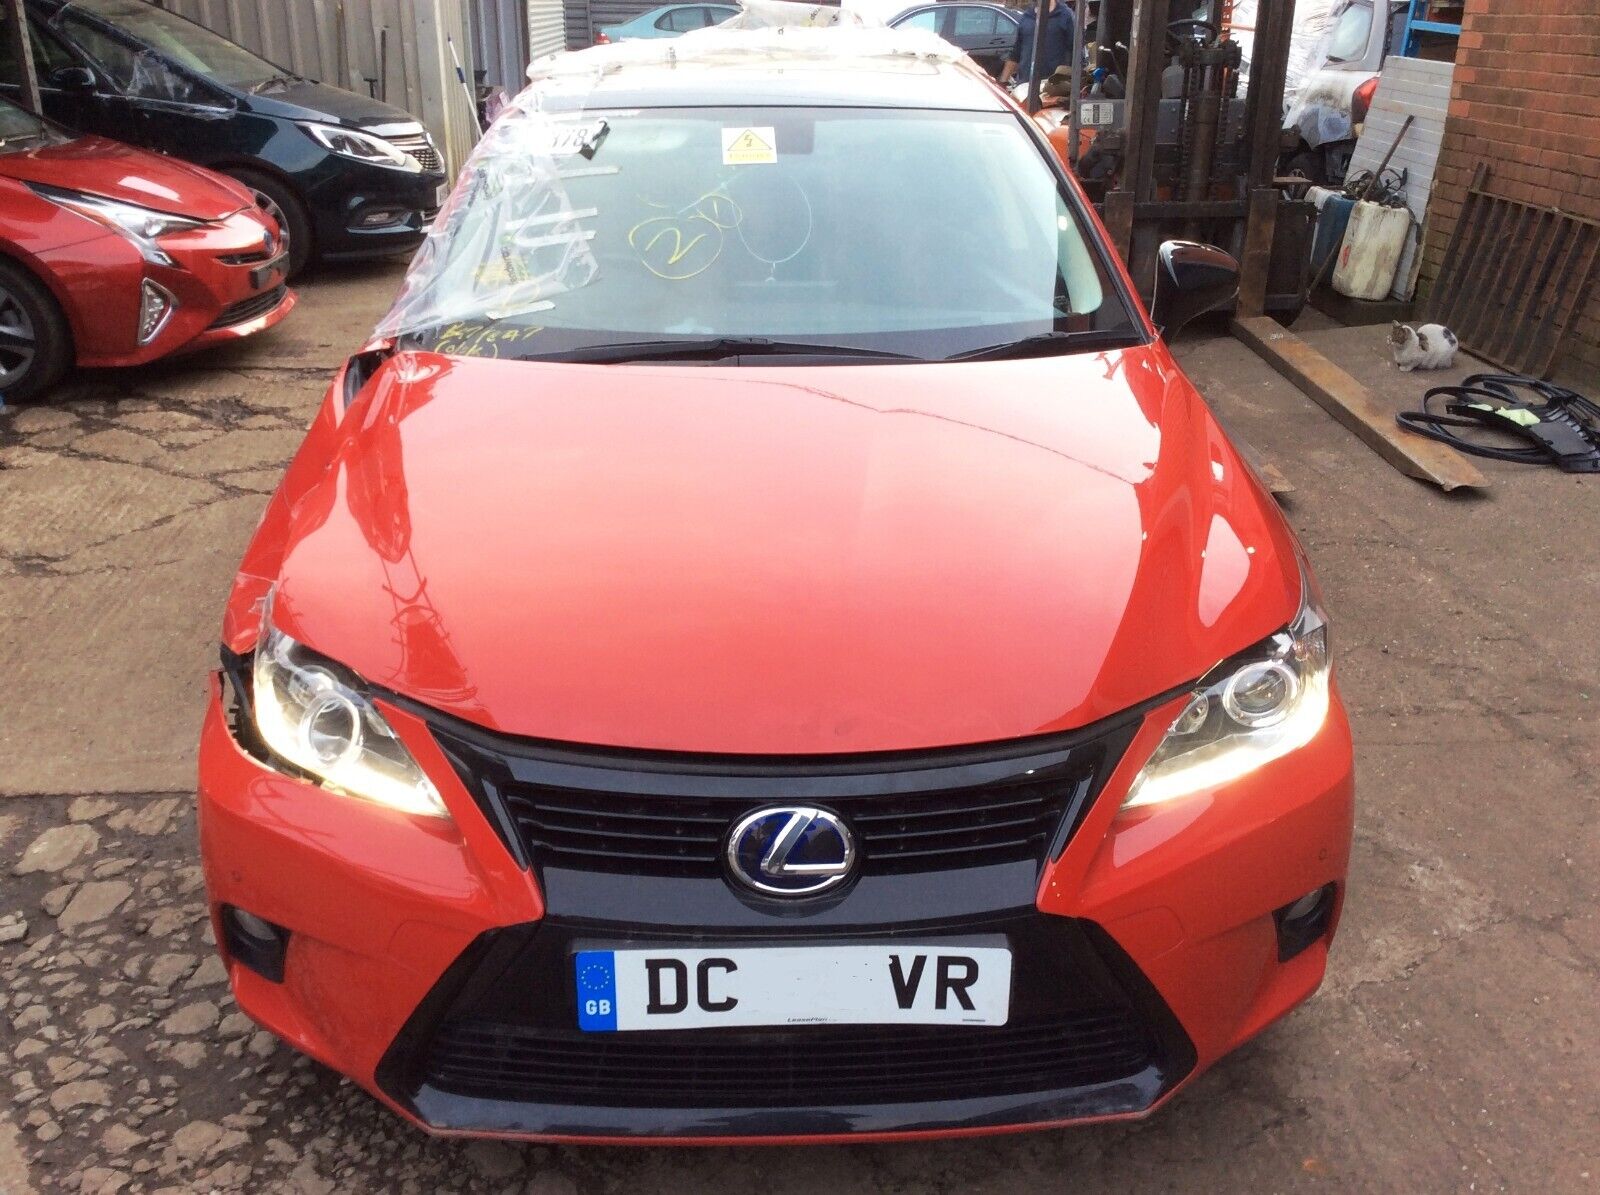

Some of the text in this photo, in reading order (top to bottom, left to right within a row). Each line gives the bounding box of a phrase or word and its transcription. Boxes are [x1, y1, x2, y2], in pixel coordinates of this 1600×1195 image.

[645, 955, 979, 1014] DC VR
[585, 999, 611, 1015] GB
